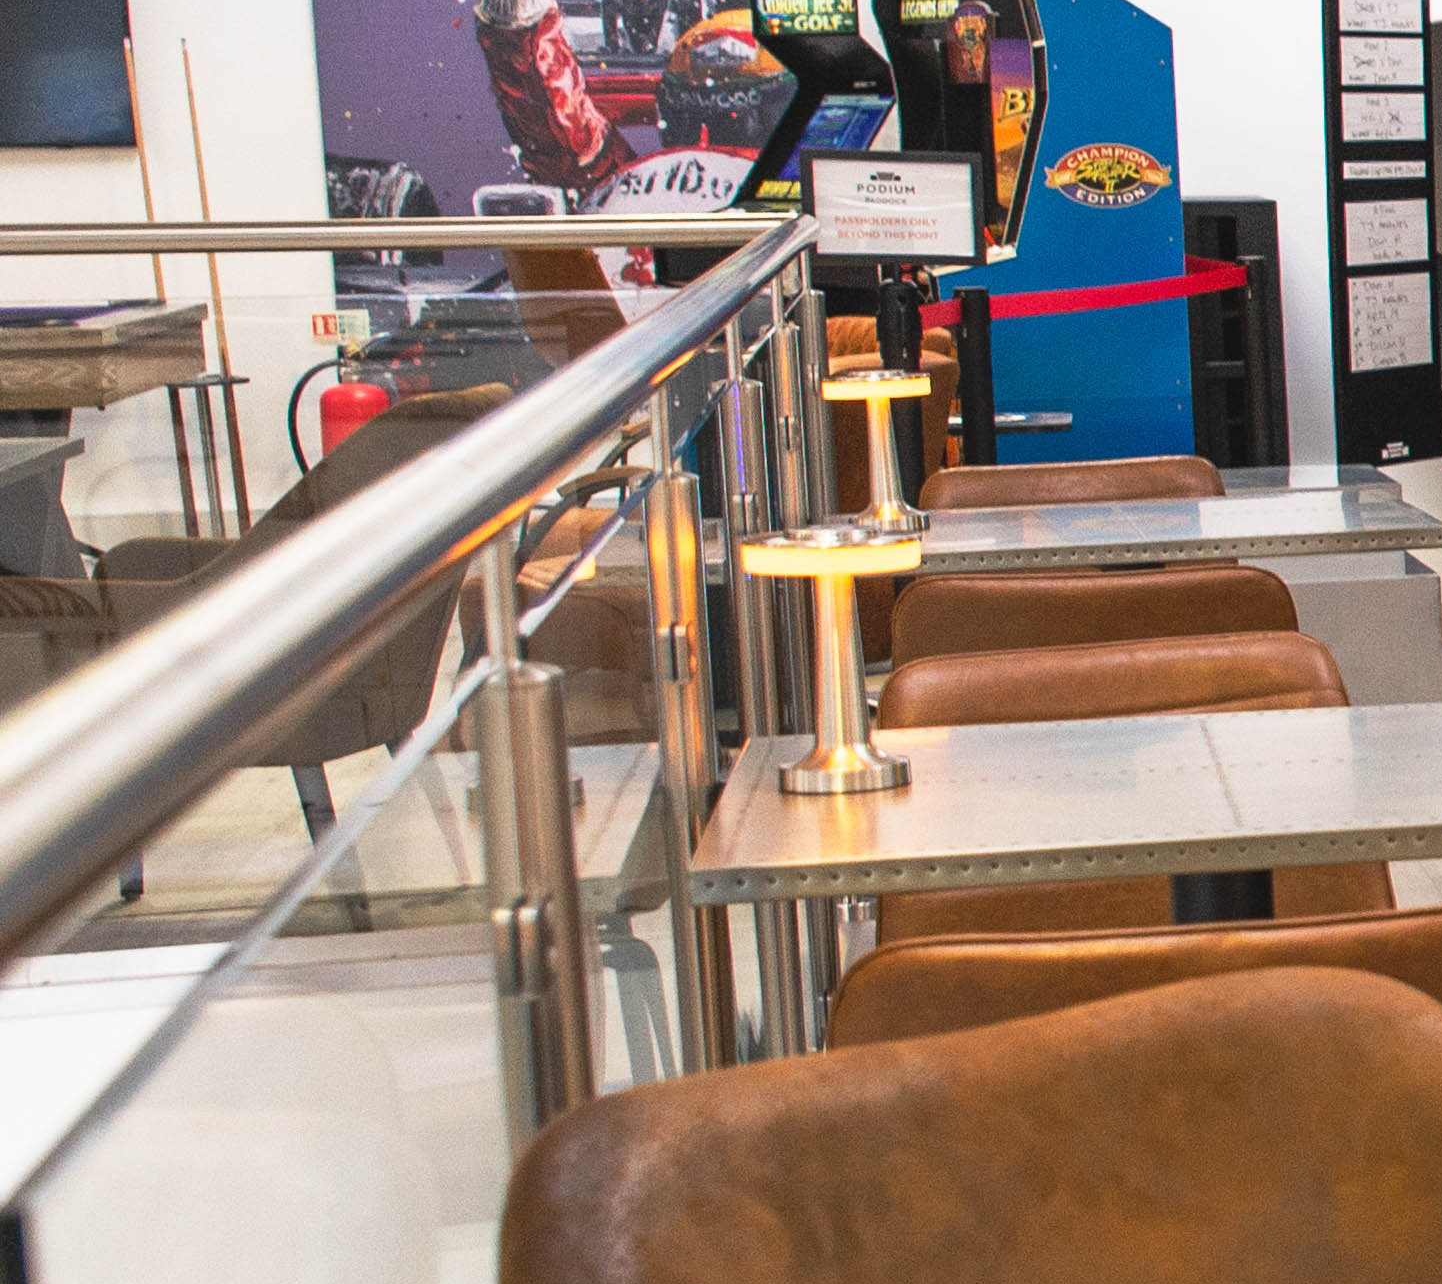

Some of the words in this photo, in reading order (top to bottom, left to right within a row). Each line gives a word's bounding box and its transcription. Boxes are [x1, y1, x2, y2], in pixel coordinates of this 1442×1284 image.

[1067, 147, 1150, 169] CHAMPION
[857, 183, 917, 195] PODIUM
[1076, 187, 1147, 205] EDITION
[834, 217, 908, 227] PASSHOLDERS
[909, 218, 938, 226] ONLY
[837, 230, 881, 240] BEYOND
[883, 231, 906, 240] THIS
[907, 231, 939, 240] POINT
